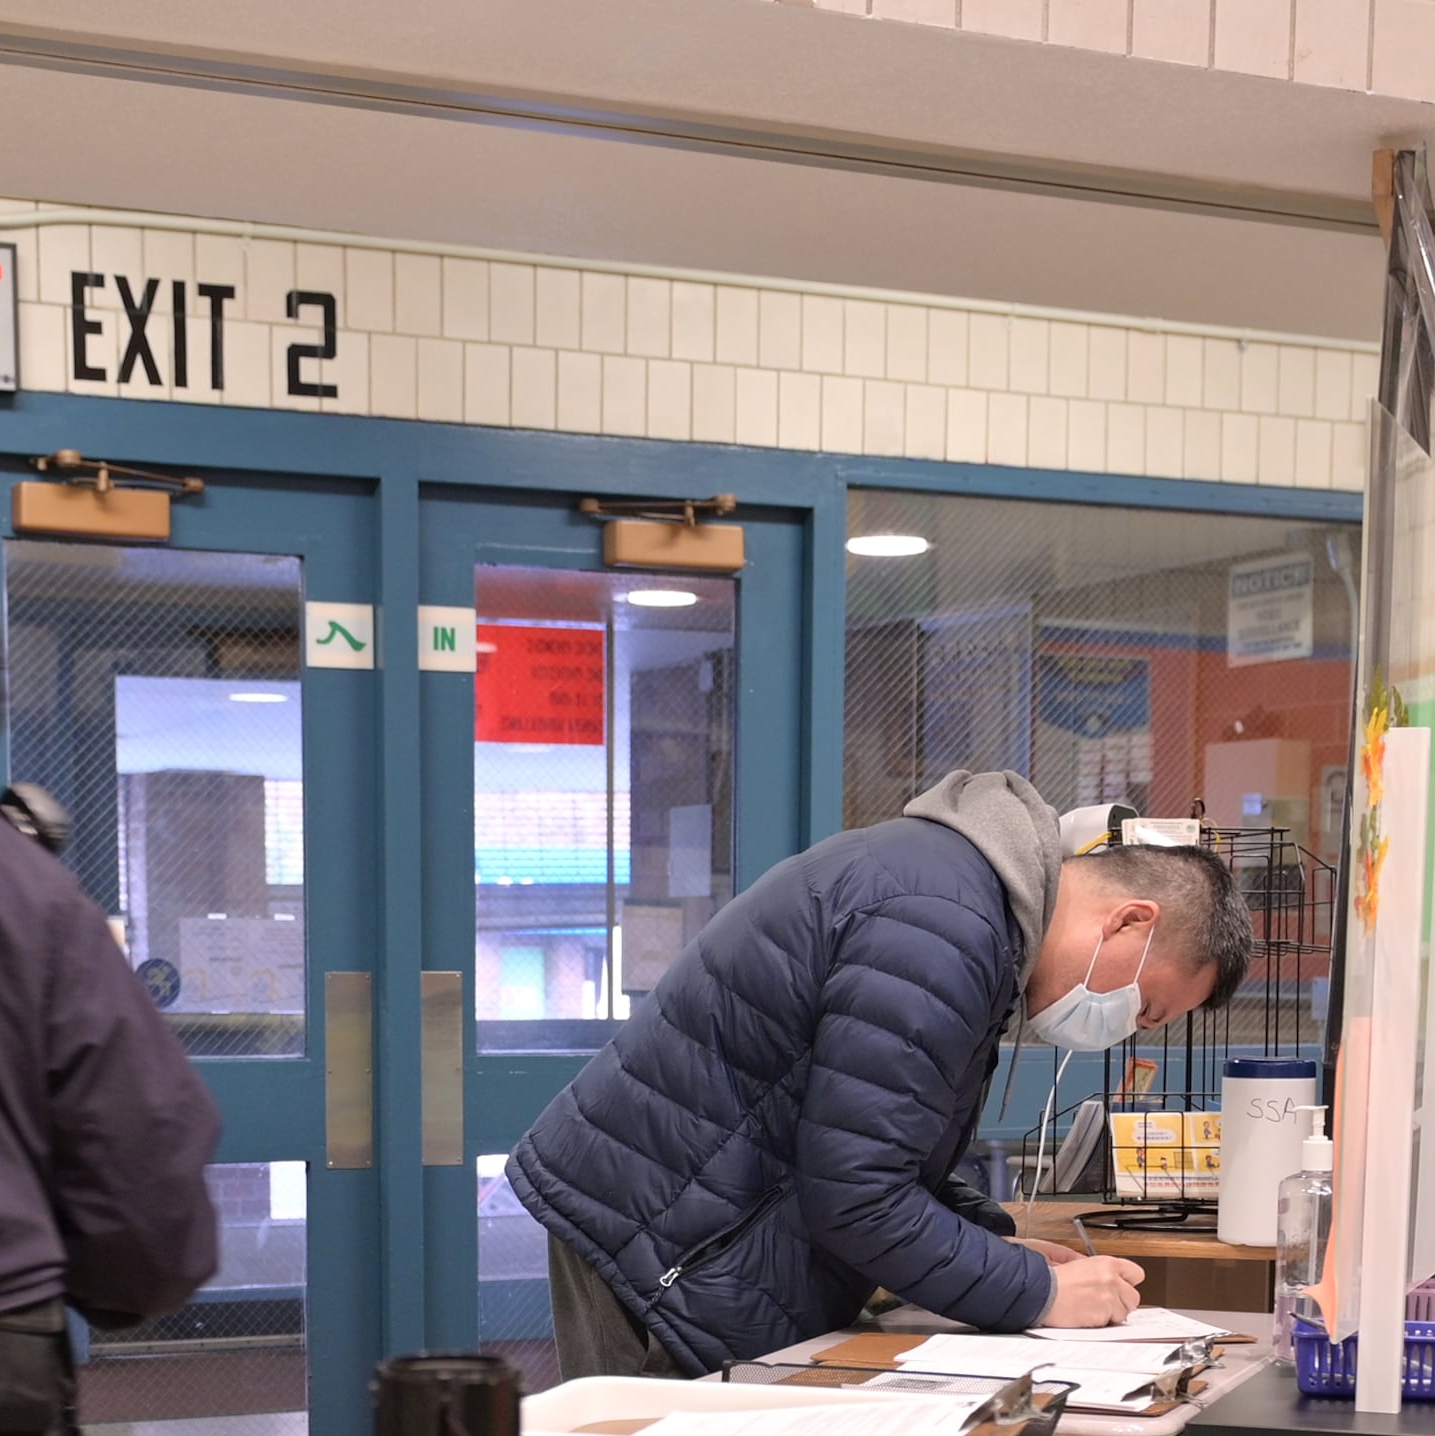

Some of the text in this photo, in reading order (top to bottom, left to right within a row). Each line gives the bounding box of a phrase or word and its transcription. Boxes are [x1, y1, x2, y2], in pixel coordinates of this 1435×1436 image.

[71, 270, 338, 398] EXIT 2
[433, 626, 456, 651] IN
[1246, 1097, 1297, 1124] SSA
